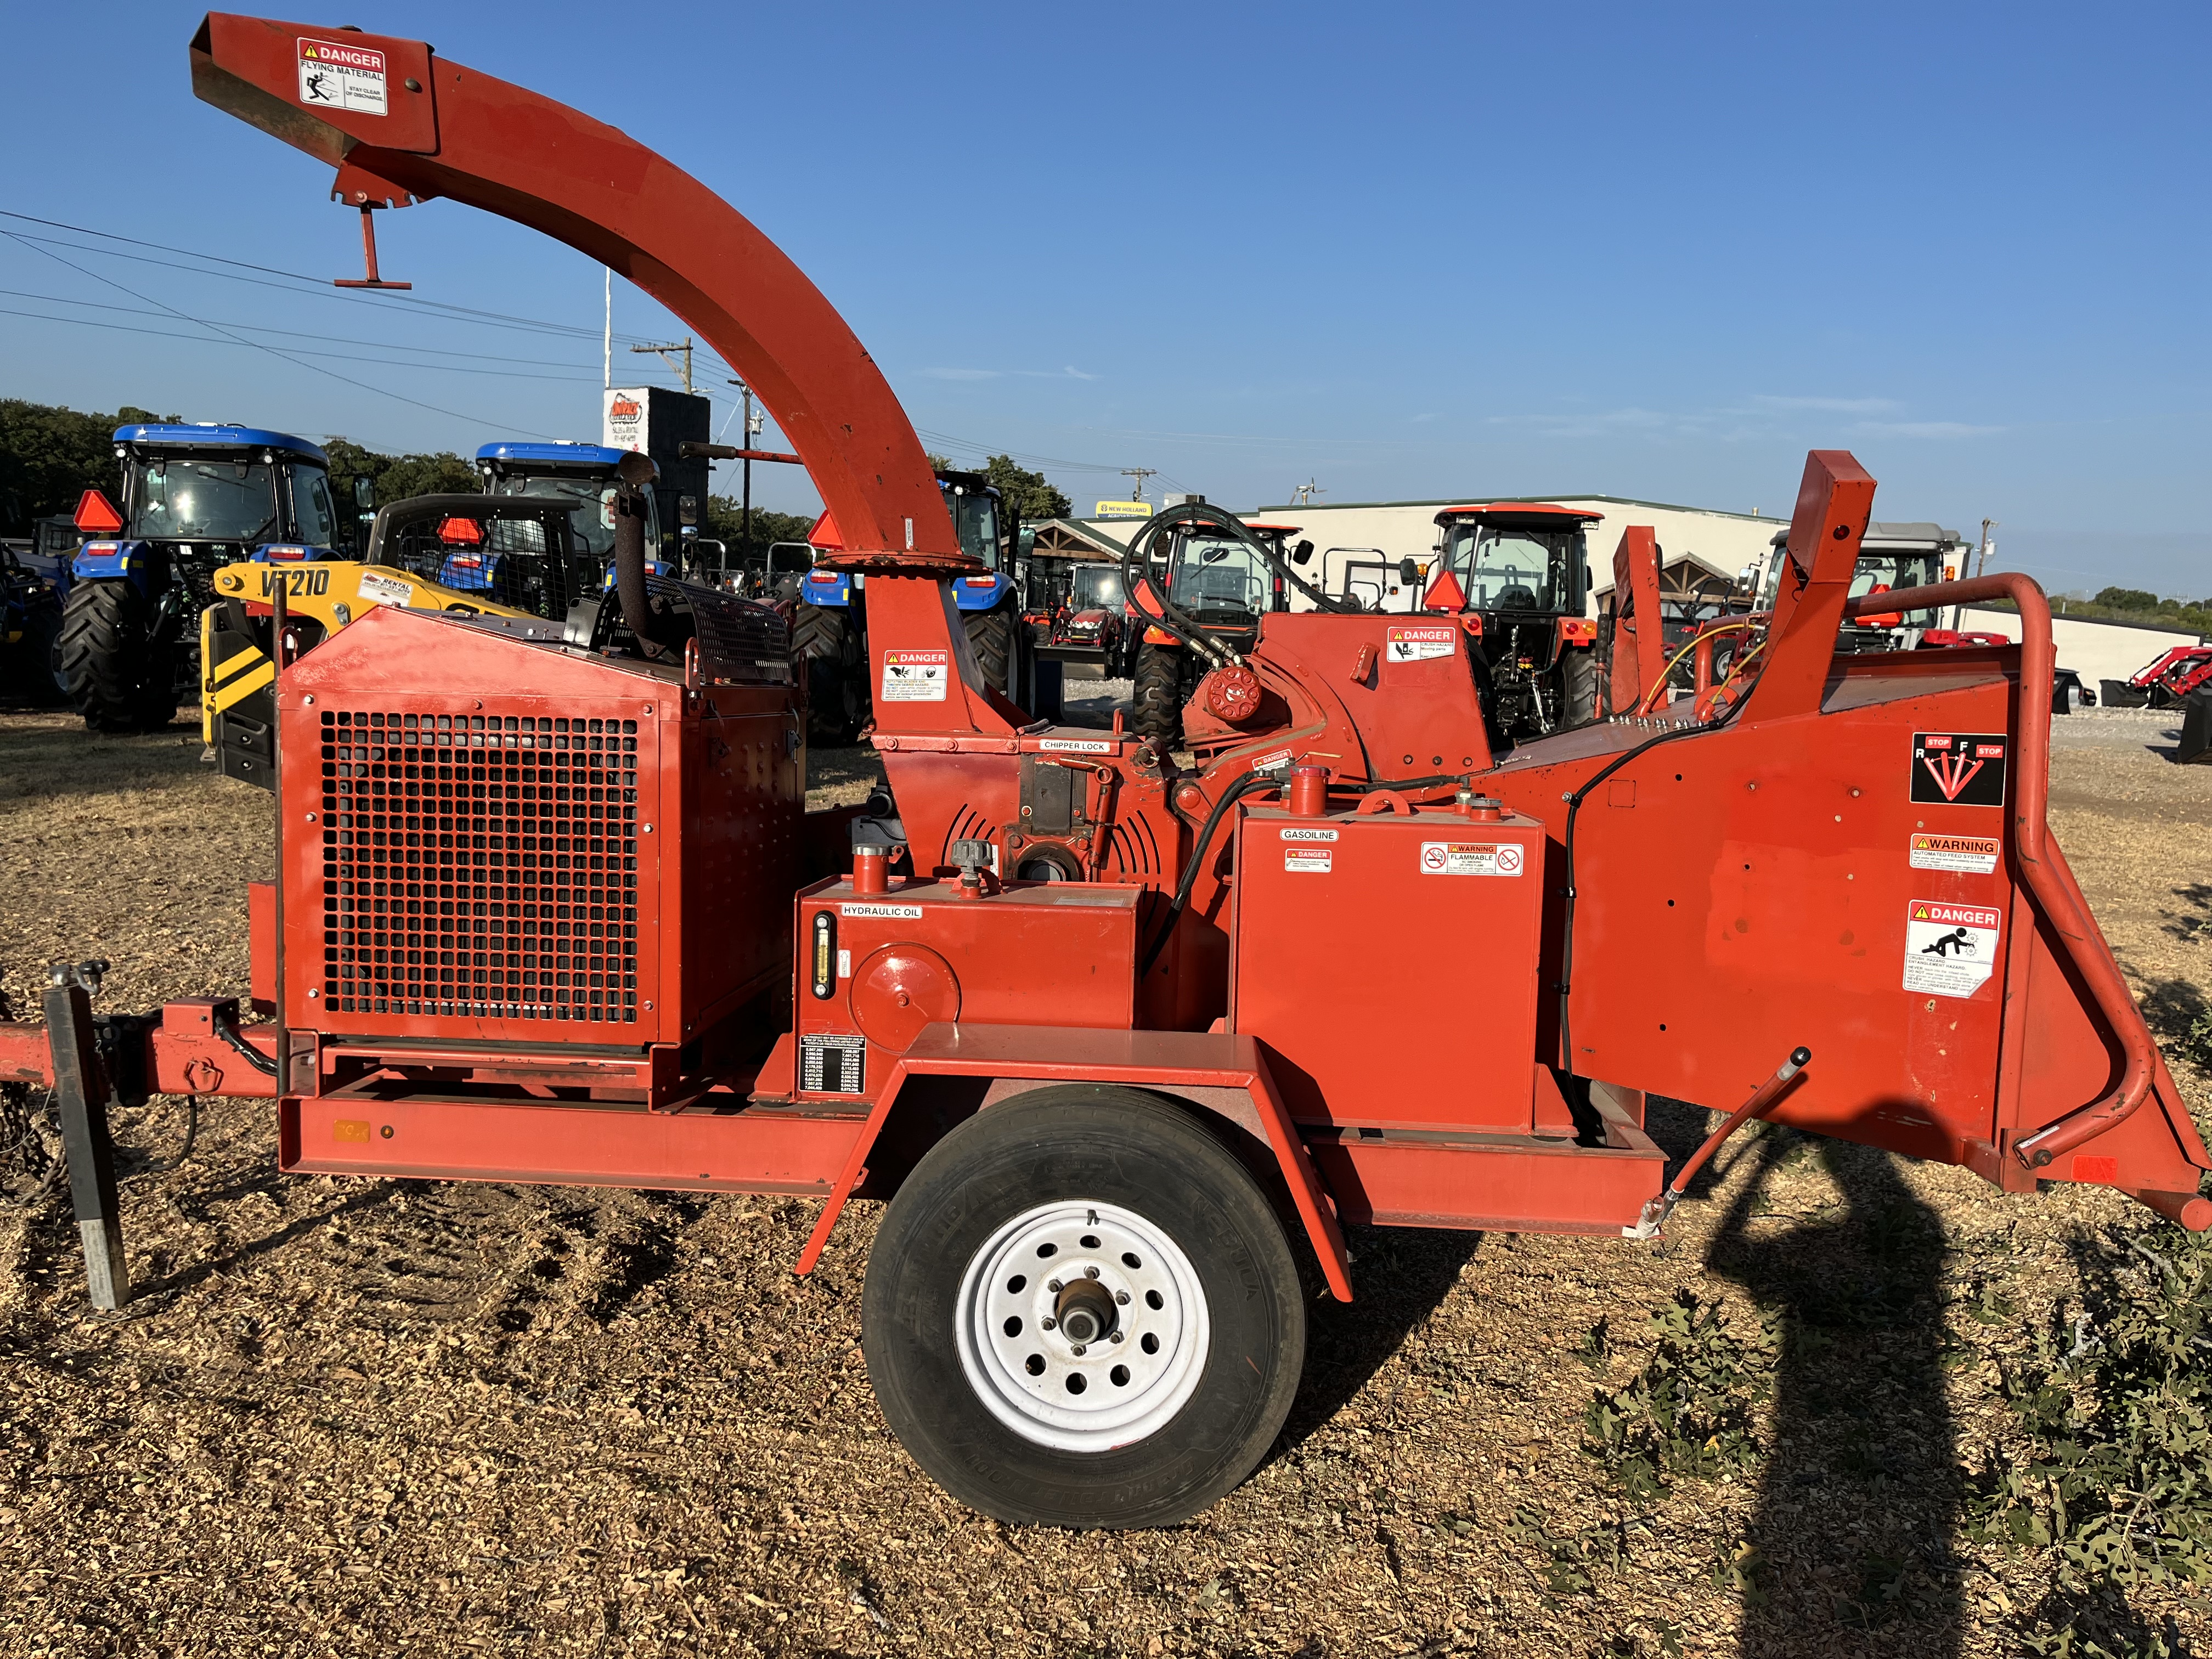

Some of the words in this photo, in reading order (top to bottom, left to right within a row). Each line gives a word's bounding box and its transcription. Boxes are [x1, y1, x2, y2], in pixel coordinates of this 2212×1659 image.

[320, 47, 381, 68] DANGER
[301, 60, 334, 72] FLYING
[337, 66, 382, 81] MATERIAL
[383, 578, 410, 590] RENTAL
[1404, 631, 1449, 640] DANGER
[900, 654, 945, 662] DANGER
[1960, 742, 1968, 751] F
[1263, 752, 1288, 763] DANGER
[1916, 748, 1925, 758] R
[1285, 831, 1334, 839] GASOILINE
[1929, 839, 1994, 853] WARNING
[844, 907, 901, 915] HYDRAULIC
[1931, 908, 1995, 925] DANGER
[1189, 1193, 1261, 1301] NEBULA
